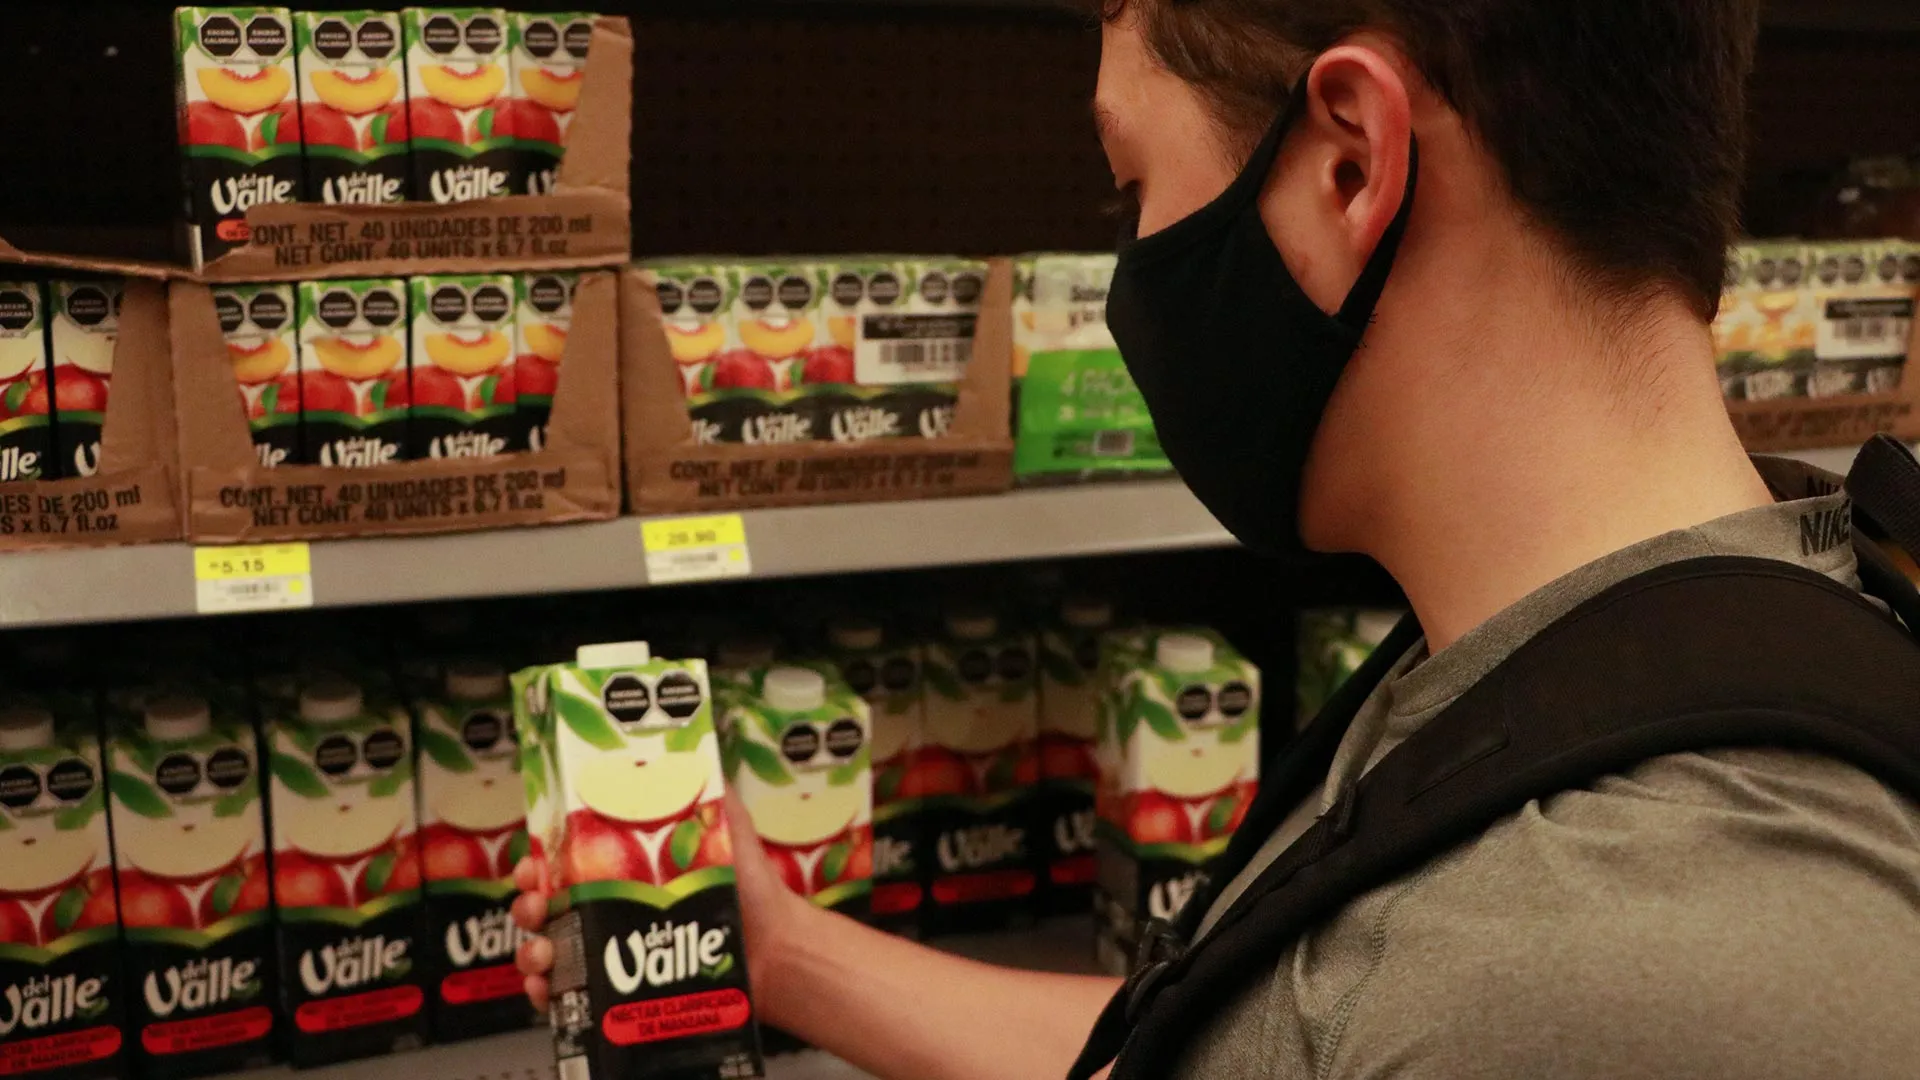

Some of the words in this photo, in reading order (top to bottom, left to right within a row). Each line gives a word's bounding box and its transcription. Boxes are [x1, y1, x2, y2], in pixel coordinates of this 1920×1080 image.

[210, 174, 293, 215] Valle
[322, 173, 399, 205] Valle
[430, 167, 507, 204] Valle
[360, 222, 384, 240] 40
[391, 217, 490, 239] UNIDADES
[497, 216, 521, 235] DE
[527, 214, 563, 235] 200
[275, 245, 312, 265] NET
[386, 241, 410, 260] 40
[416, 239, 474, 259] UNITS
[481, 242, 491, 257] x
[320, 437, 398, 469] Valle
[38, 494, 64, 514] DE
[71, 488, 109, 512] 200
[115, 484, 141, 507] ml
[338, 484, 361, 503] 40
[367, 475, 468, 501] UNIDADES
[474, 472, 500, 492] DE
[22, 518, 33, 532] x
[40, 517, 69, 533] 6.7
[253, 507, 291, 527] NET
[394, 496, 454, 520] UNITS
[1800, 499, 1850, 556] NIKE
[446, 912, 536, 966] Vall
[645, 920, 674, 948] del
[182, 957, 208, 980] del
[300, 935, 407, 995] Valle
[604, 920, 727, 995] Valle
[22, 974, 49, 998] del
[144, 956, 256, 1017] Valle
[0, 974, 102, 1034] Valle
